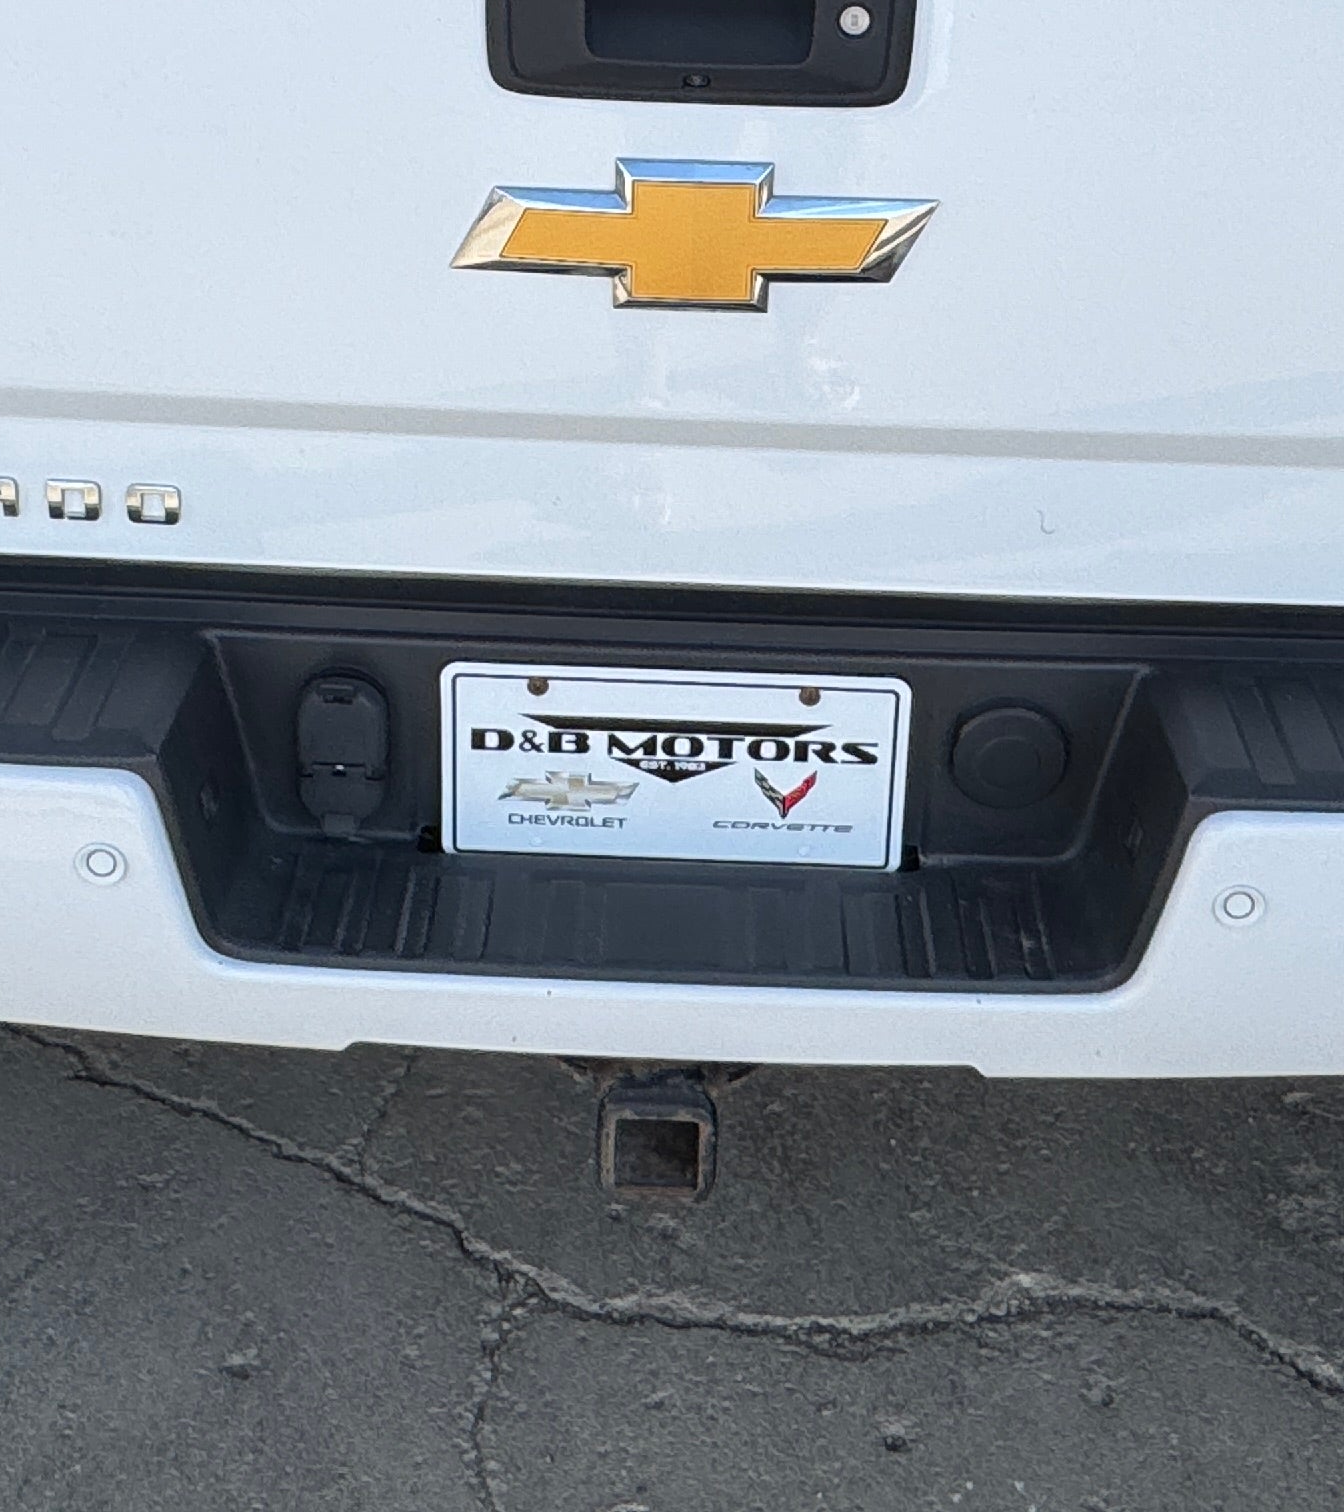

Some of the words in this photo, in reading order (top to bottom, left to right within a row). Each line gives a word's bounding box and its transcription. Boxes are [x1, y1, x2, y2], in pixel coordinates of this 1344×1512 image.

[470, 727, 591, 754] D&B
[608, 733, 879, 765] MOTORS
[508, 813, 628, 829] CHEVROLET
[712, 819, 854, 833] CORVETTE
